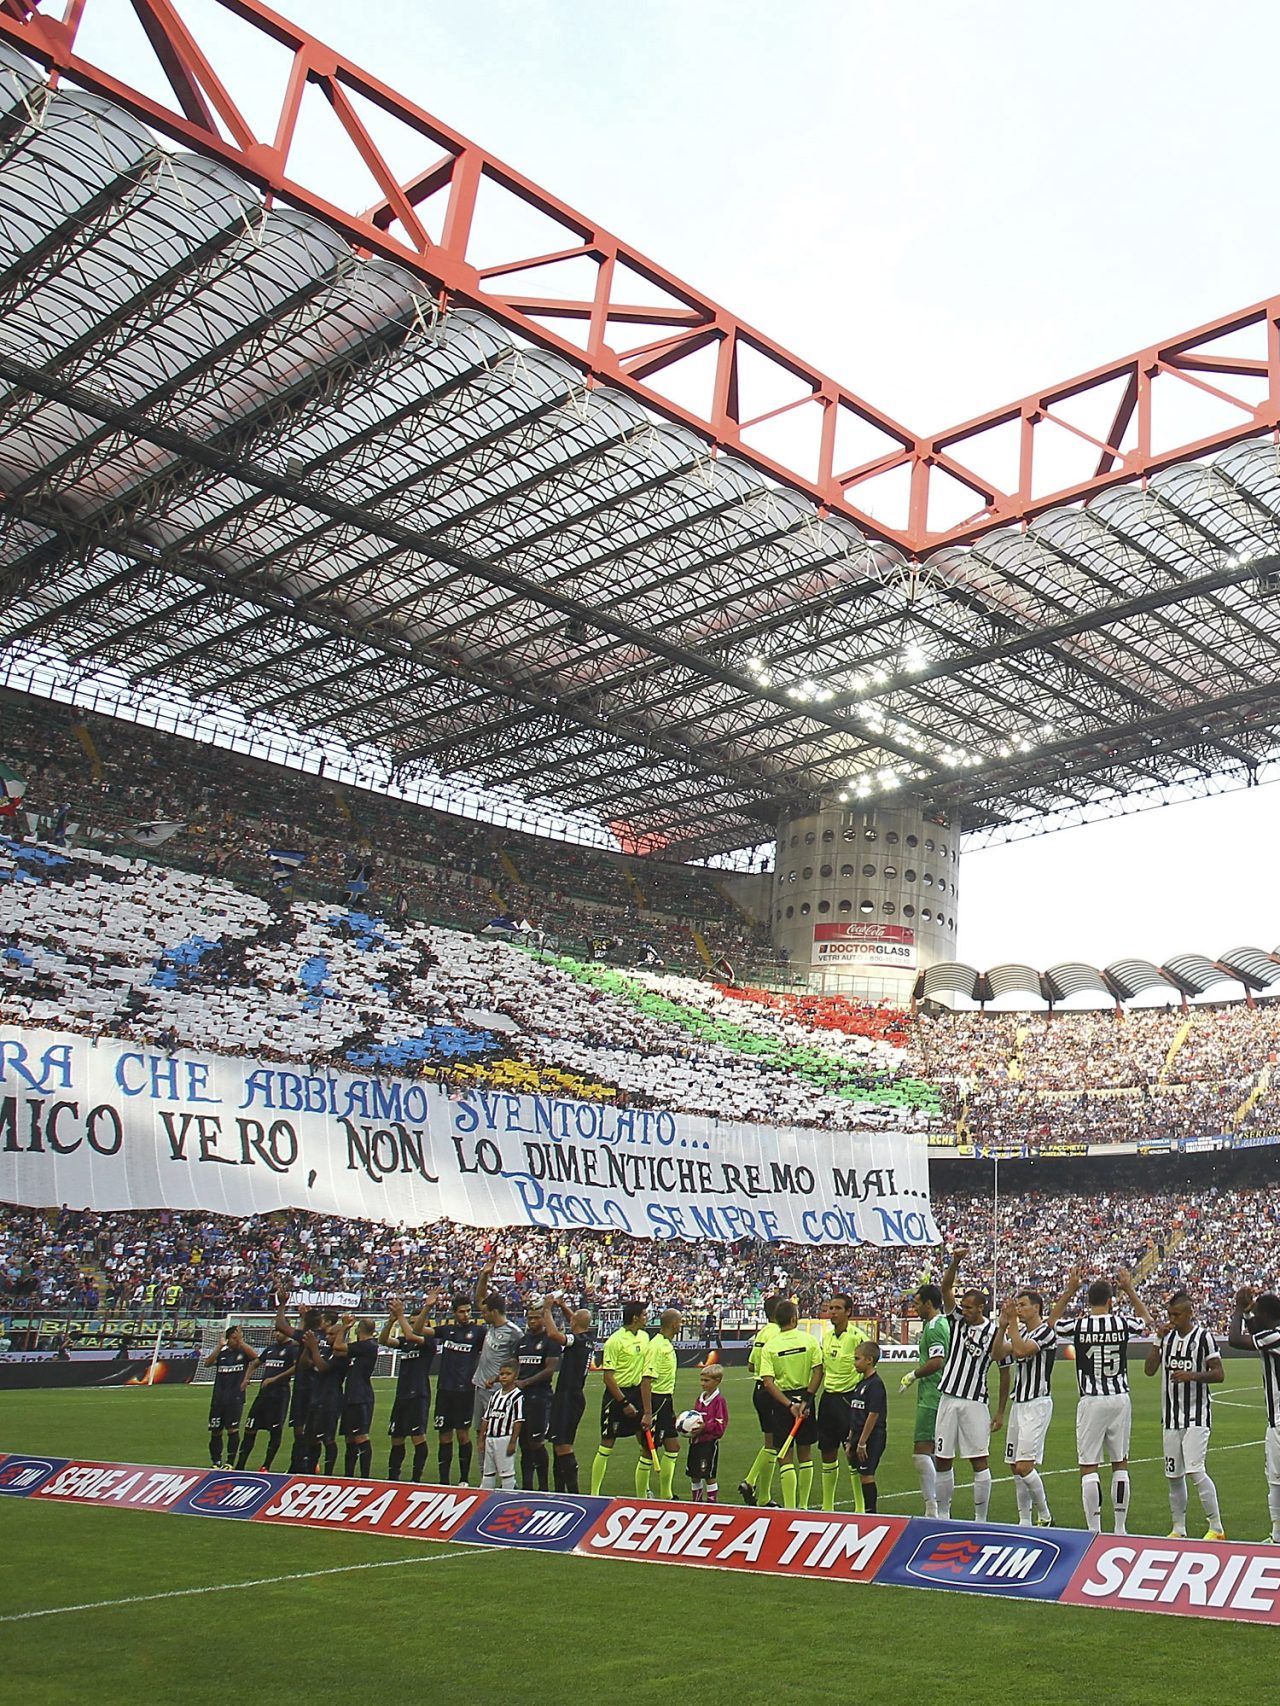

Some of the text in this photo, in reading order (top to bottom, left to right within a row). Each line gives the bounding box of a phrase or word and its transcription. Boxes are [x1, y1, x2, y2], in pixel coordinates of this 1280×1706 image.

[830, 944, 910, 957] DOCTORGLASS
[0, 1039, 75, 1095] RA
[116, 1051, 224, 1104] CHE
[238, 1069, 430, 1124] ABBIAMO
[337, 1117, 440, 1184] NON
[451, 1135, 502, 1177] LO
[523, 1141, 816, 1199] DIMENTICHEREMO
[647, 1203, 794, 1243] SEMPRE
[872, 1206, 936, 1244] NOI
[42, 1320, 174, 1334] BOLOGNA
[1080, 1333, 1125, 1343] BARZAGLI
[964, 1340, 982, 1357] eep
[1085, 1344, 1121, 1379] 15
[1166, 1355, 1193, 1370] Jeep
[211, 1417, 221, 1428] 55
[937, 1438, 943, 1452] 3
[10, 1468, 45, 1487] TIM
[41, 1466, 200, 1506] SERIE A TIM
[218, 1485, 262, 1507] TIM
[265, 1482, 478, 1531] SERIE A TIM
[519, 1510, 575, 1537] TIM
[591, 1506, 891, 1571] SERIE A TIM
[969, 1545, 1043, 1579] TIM
